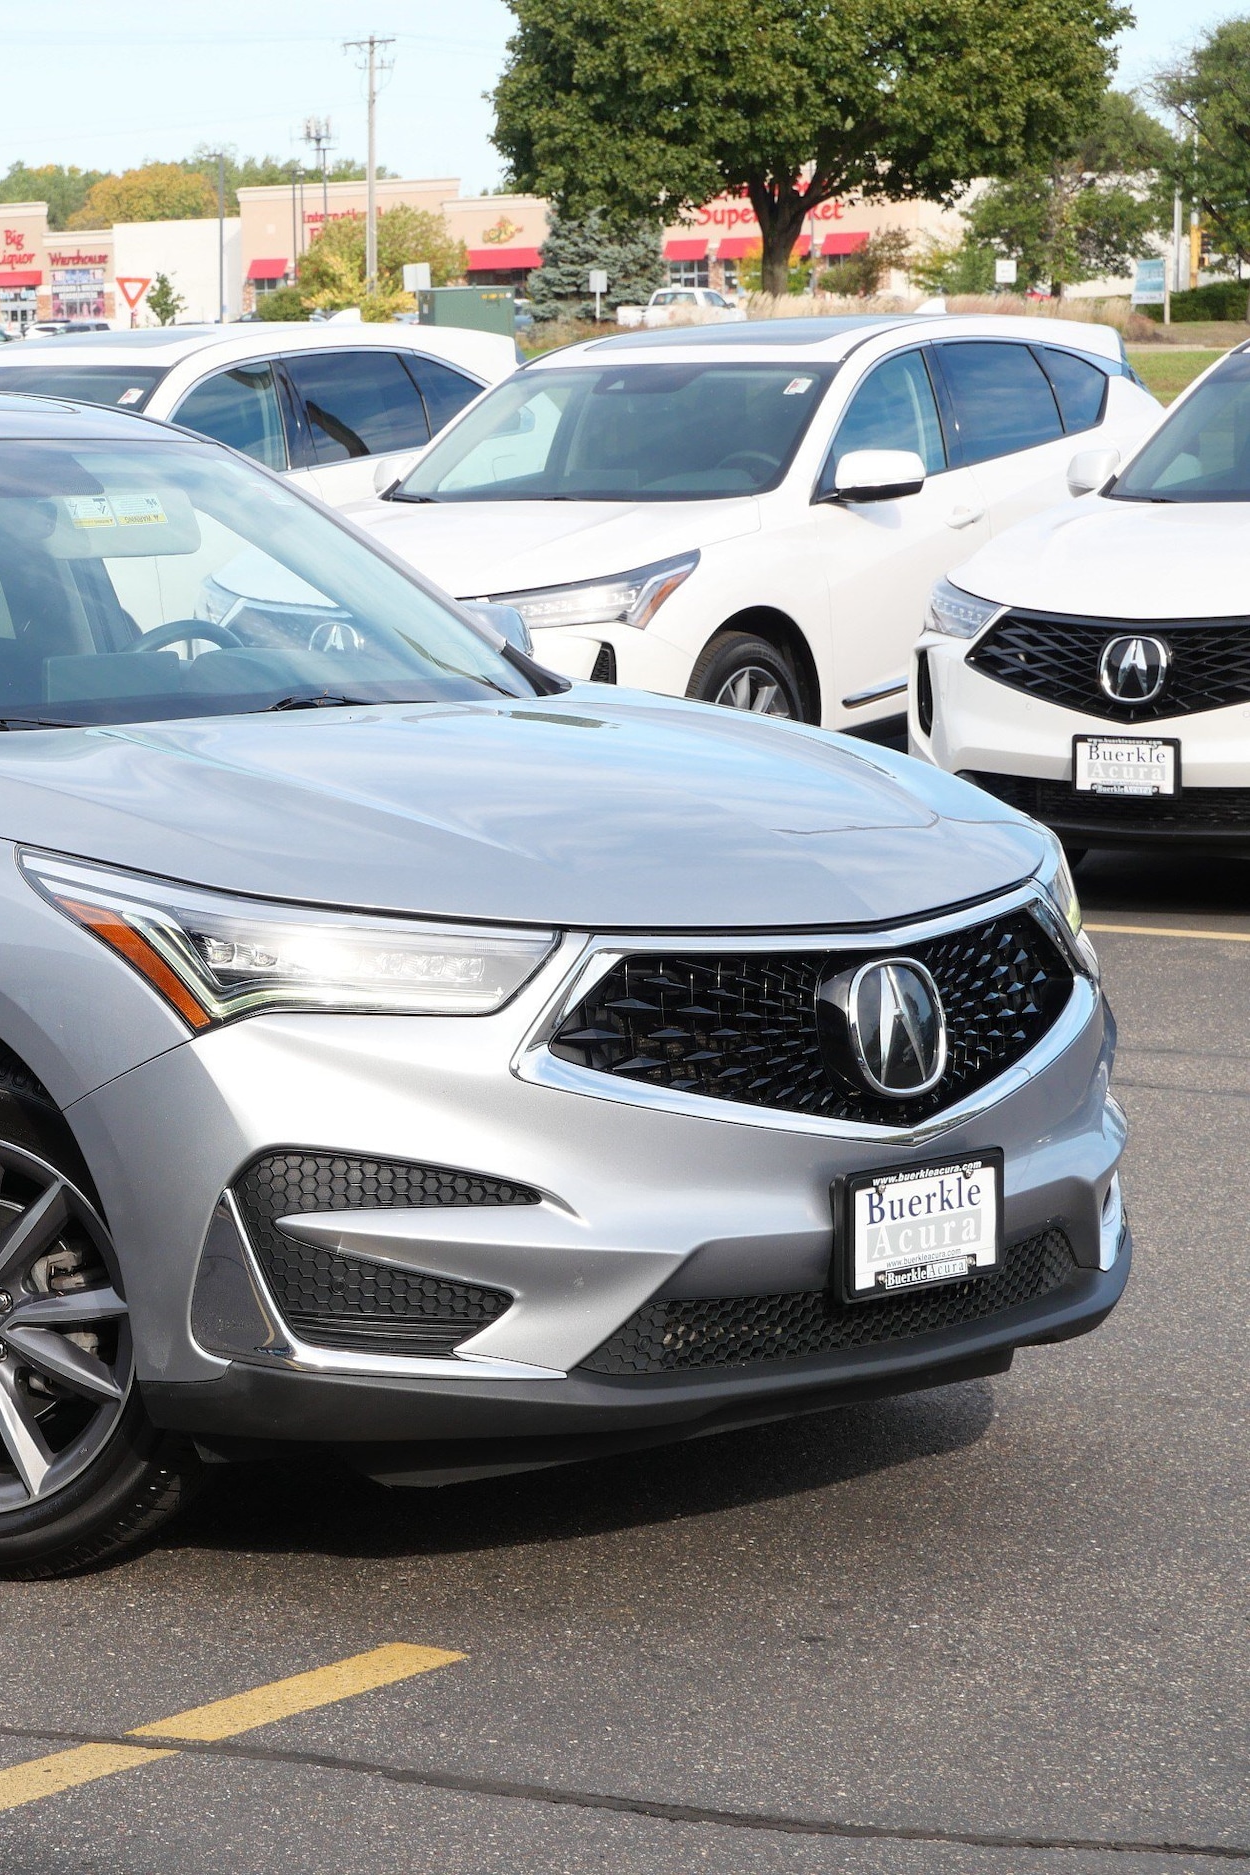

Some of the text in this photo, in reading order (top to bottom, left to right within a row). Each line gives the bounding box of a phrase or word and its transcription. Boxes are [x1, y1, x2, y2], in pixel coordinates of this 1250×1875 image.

[697, 201, 844, 231] Supeket
[4, 229, 25, 251] Big
[1088, 745, 1165, 763] Buerkle
[1091, 763, 1163, 780] Acura
[872, 1160, 982, 1187] www.buerkleacura.com
[866, 1176, 981, 1226] Buerkle
[872, 1217, 977, 1259] Acura
[886, 1248, 962, 1269] www.buerkleacura.com
